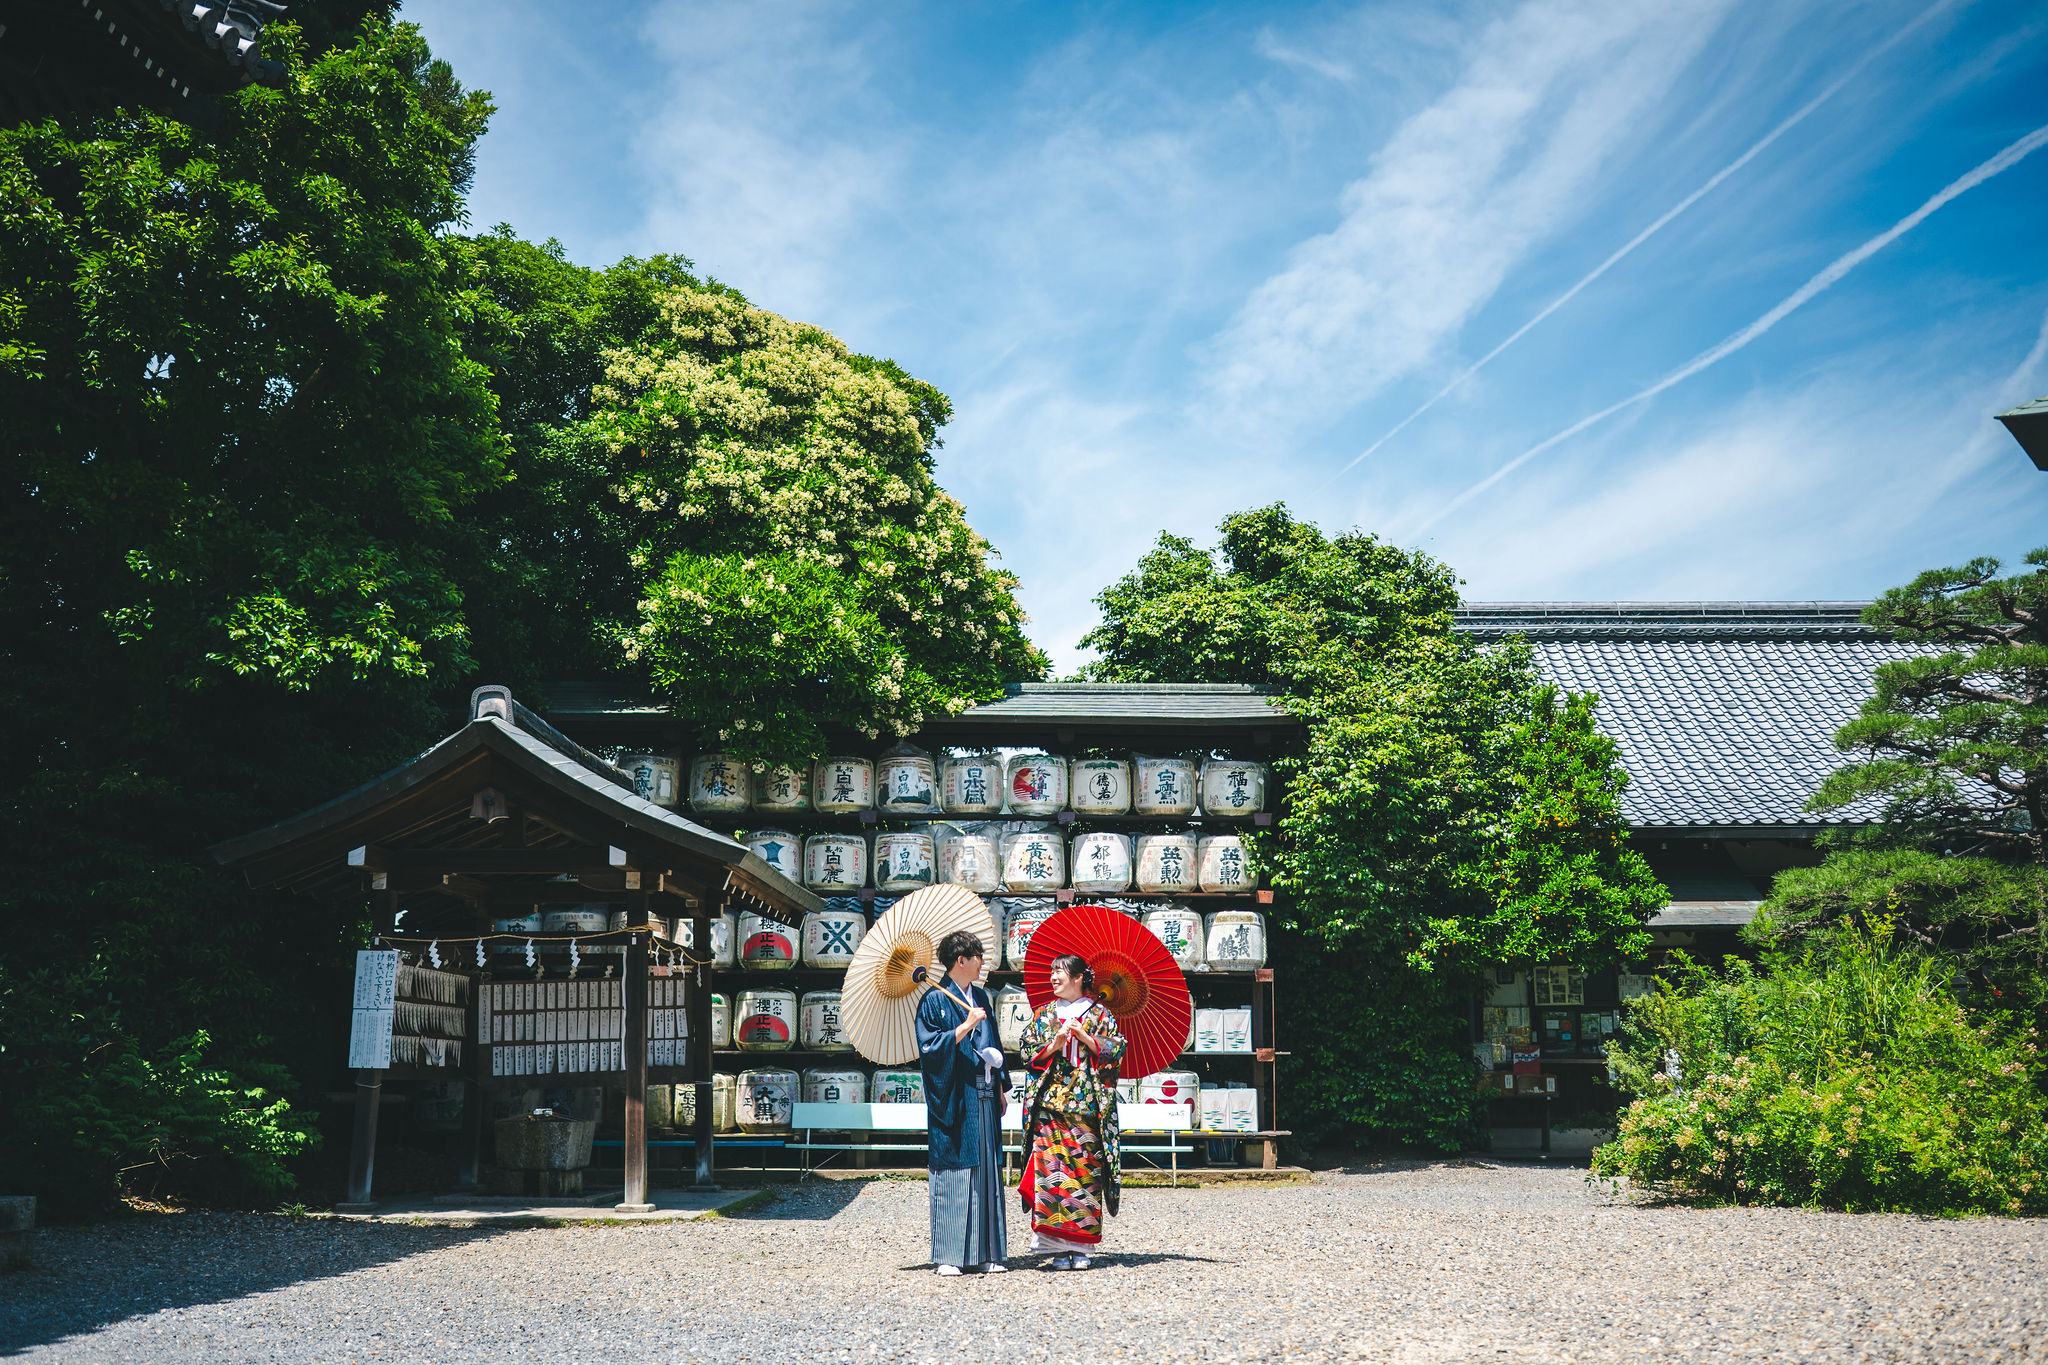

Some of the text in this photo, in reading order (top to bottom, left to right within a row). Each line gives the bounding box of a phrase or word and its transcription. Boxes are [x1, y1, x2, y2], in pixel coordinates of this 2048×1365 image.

[832, 772, 855, 802] 白鹿
[898, 770, 910, 795] 白鶴
[964, 767, 986, 805] 日本盛
[1155, 769, 1178, 805] 白鷹
[821, 852, 845, 883] 白鹿
[899, 848, 911, 872] 白鶴
[1025, 842, 1049, 879] 黄桜
[1091, 844, 1112, 880] 都鶴
[818, 1011, 842, 1044] 白鹿
